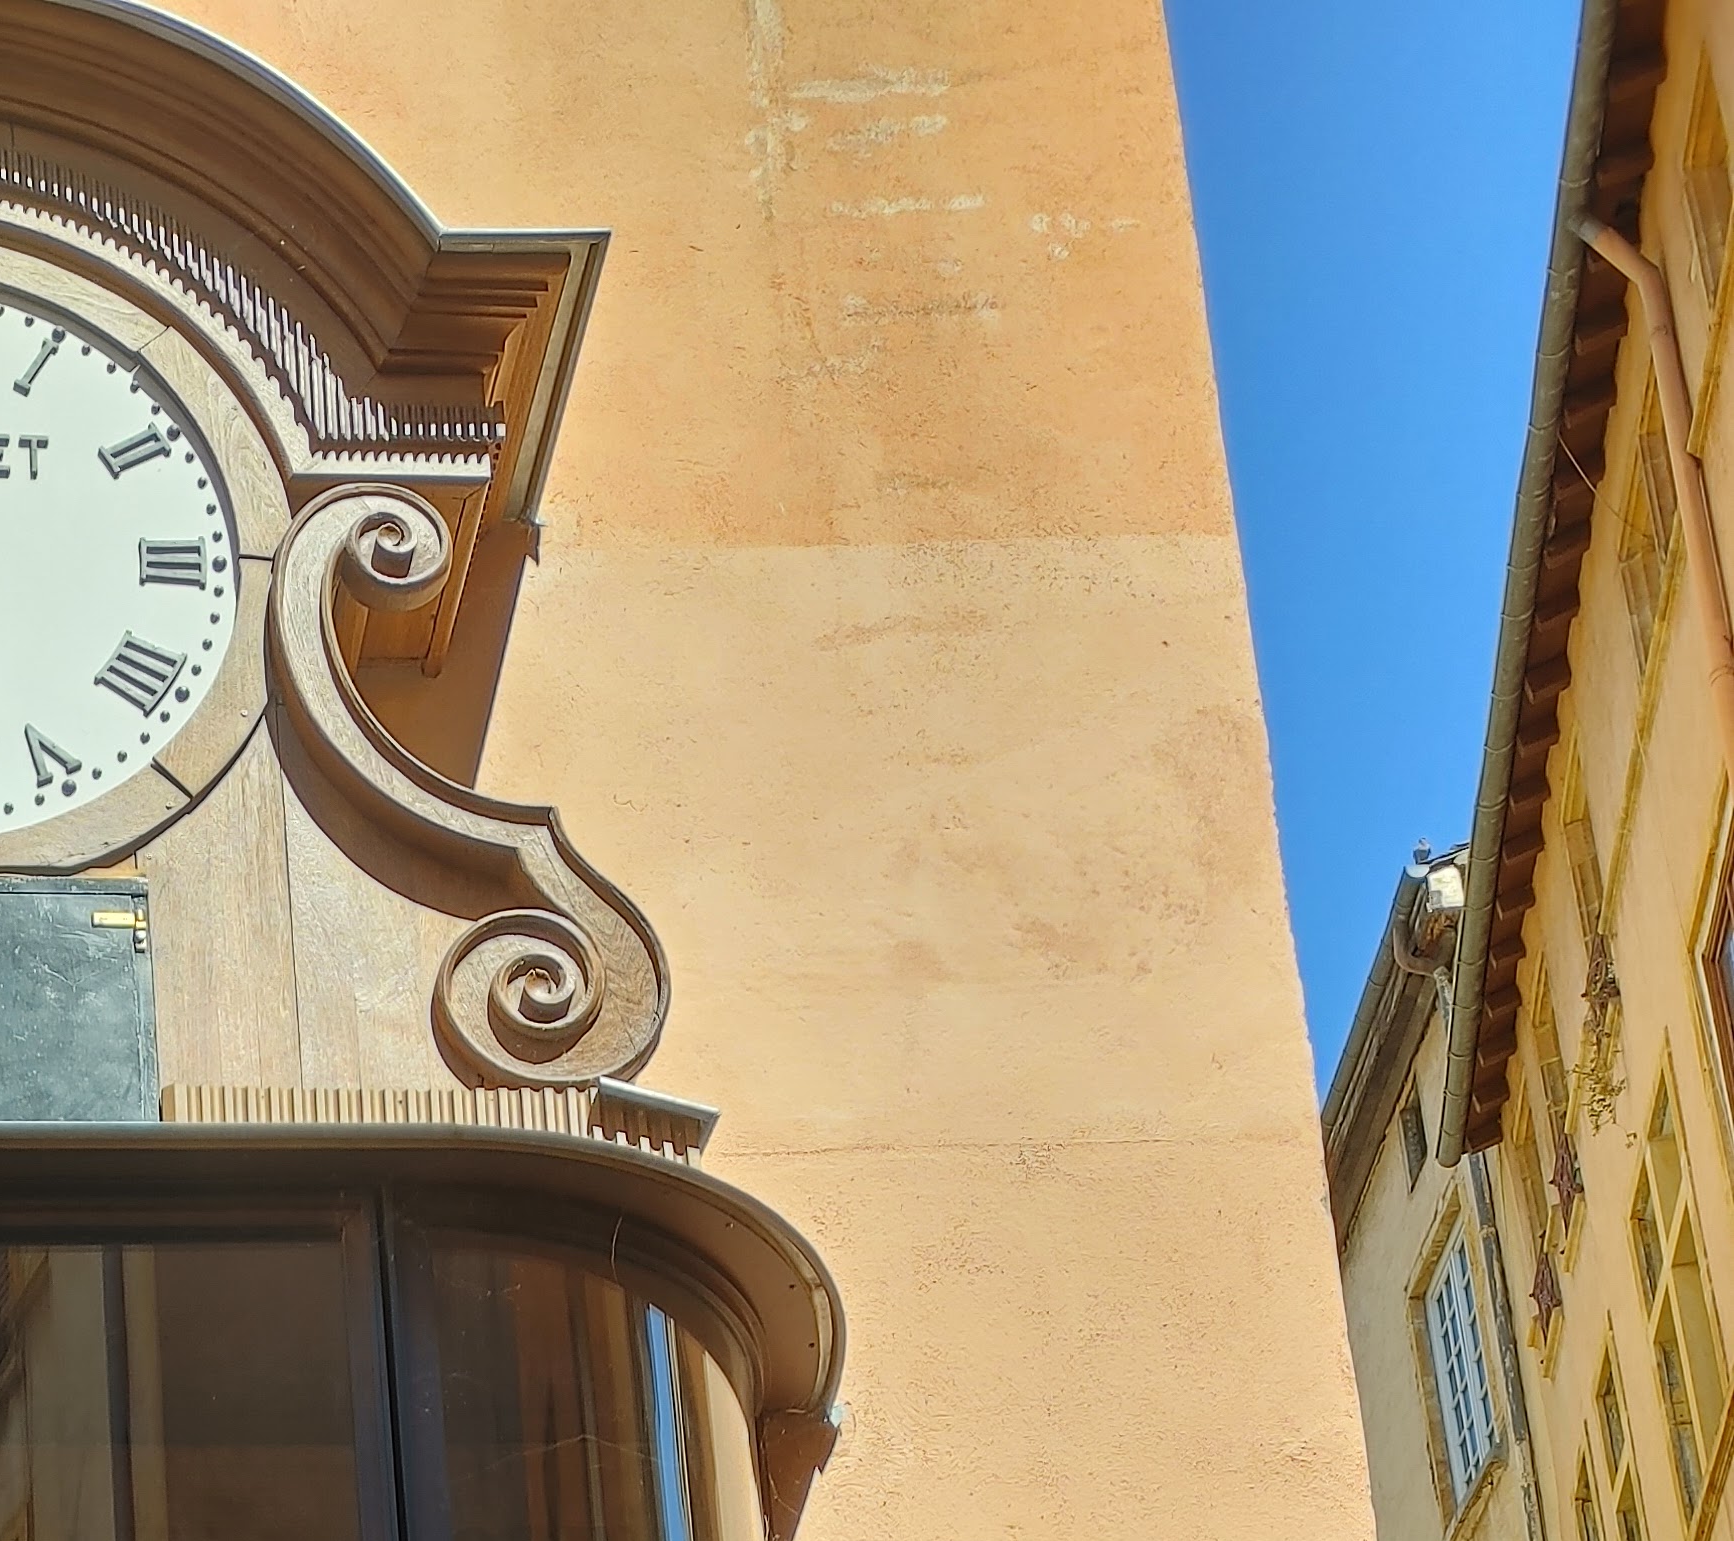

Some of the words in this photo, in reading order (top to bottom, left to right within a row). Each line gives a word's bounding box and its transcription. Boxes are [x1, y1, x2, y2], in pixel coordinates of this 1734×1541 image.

[14, 339, 57, 396] I
[98, 423, 171, 478] II
[139, 536, 207, 589] III
[95, 631, 187, 716] IIII
[24, 724, 81, 786] V
